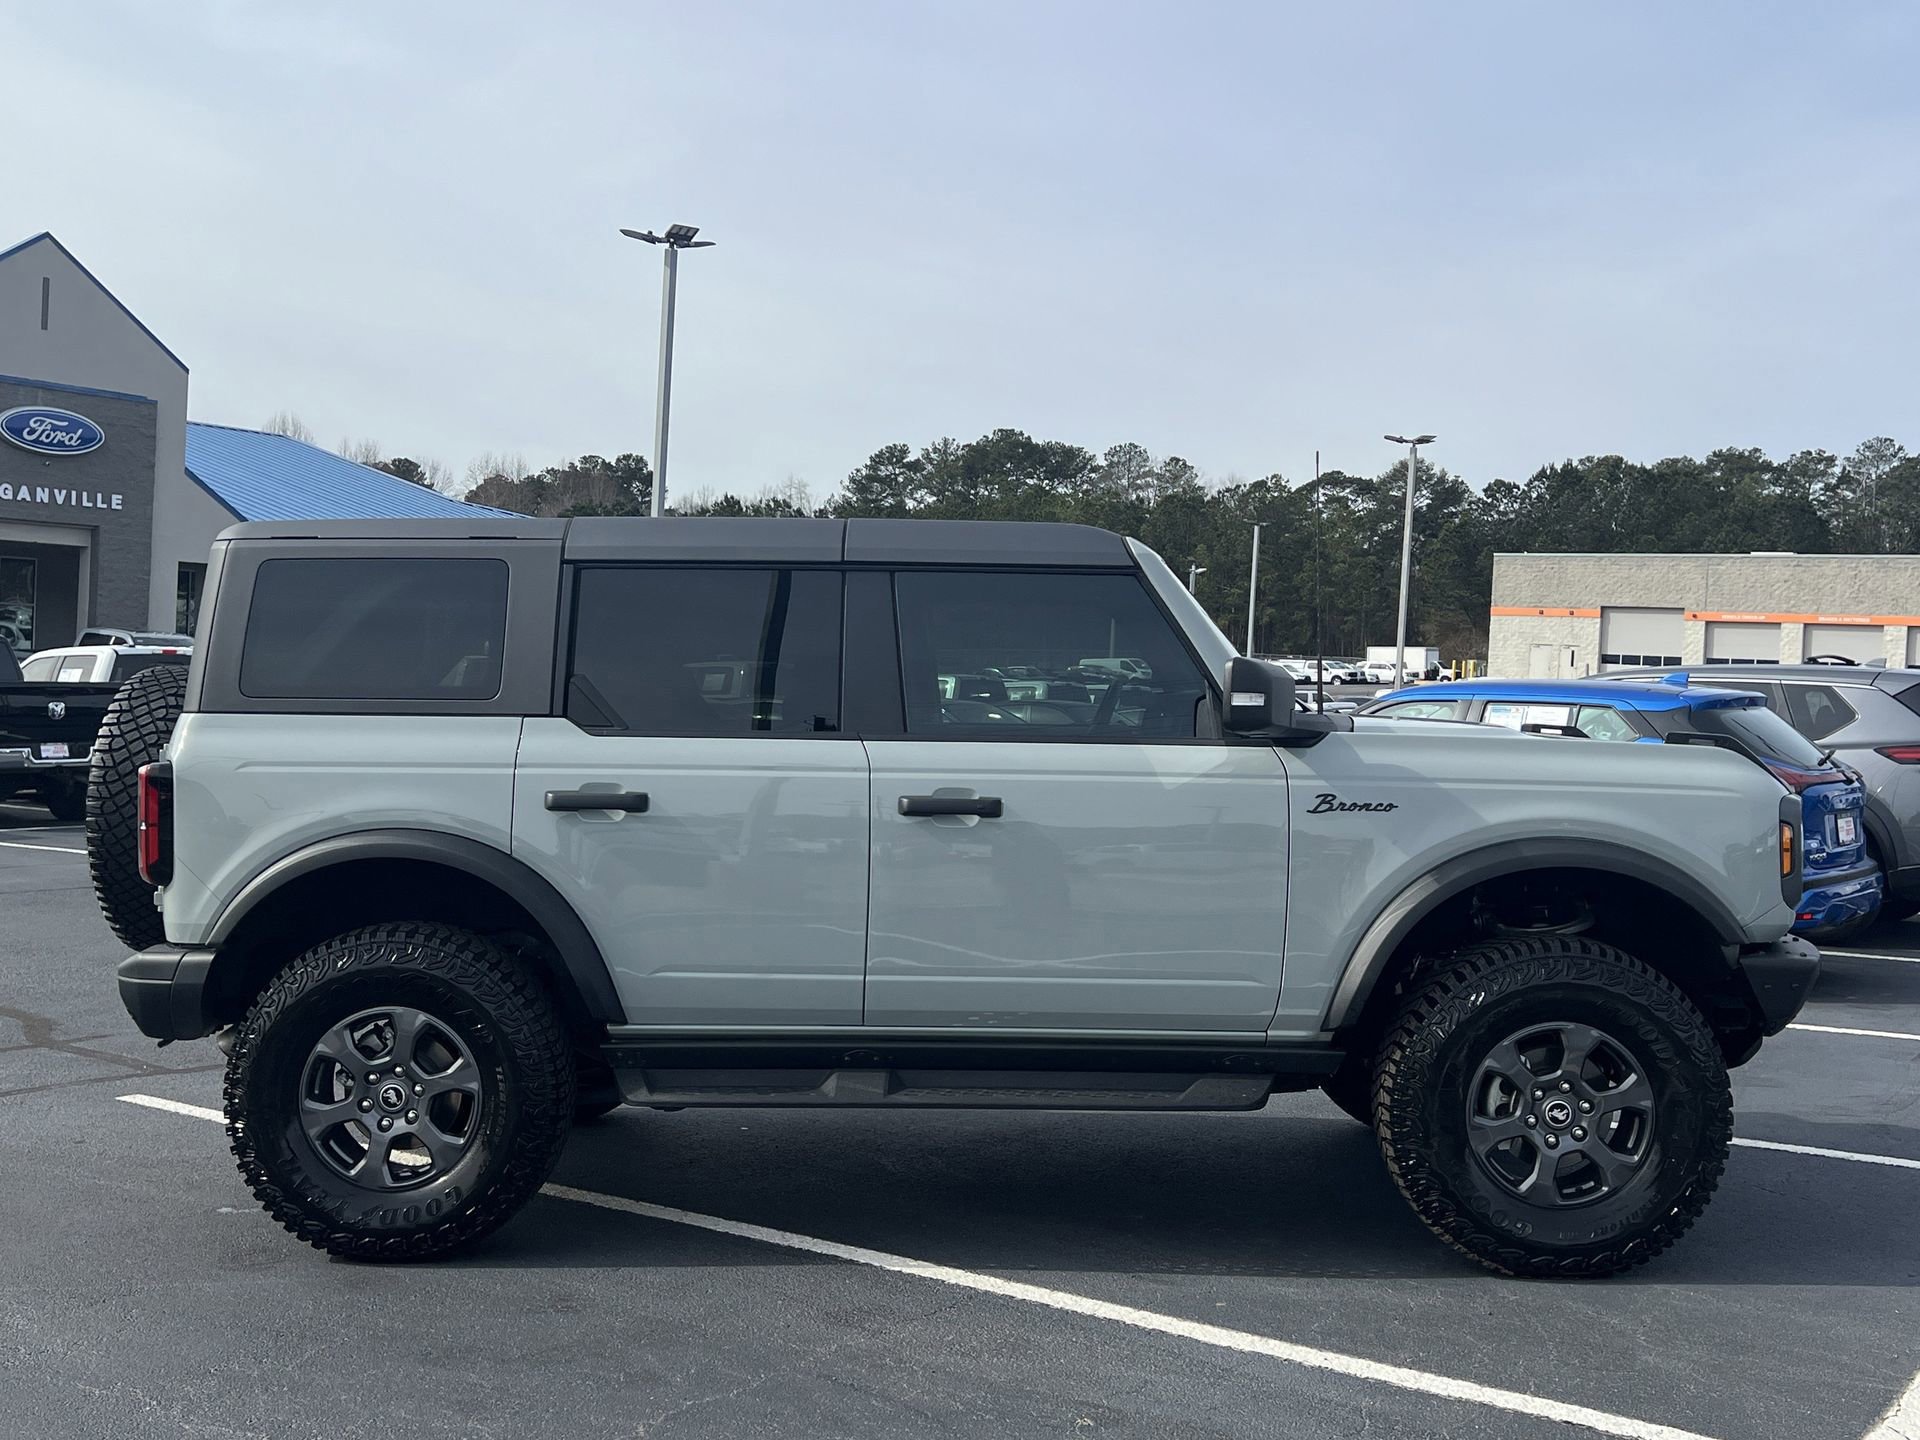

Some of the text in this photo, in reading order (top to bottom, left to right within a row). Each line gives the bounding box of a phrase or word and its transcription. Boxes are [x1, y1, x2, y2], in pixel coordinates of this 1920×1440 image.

[22, 416, 83, 446] Ford
[0, 483, 123, 510] GANVILLE
[1306, 793, 1399, 814] Bronco
